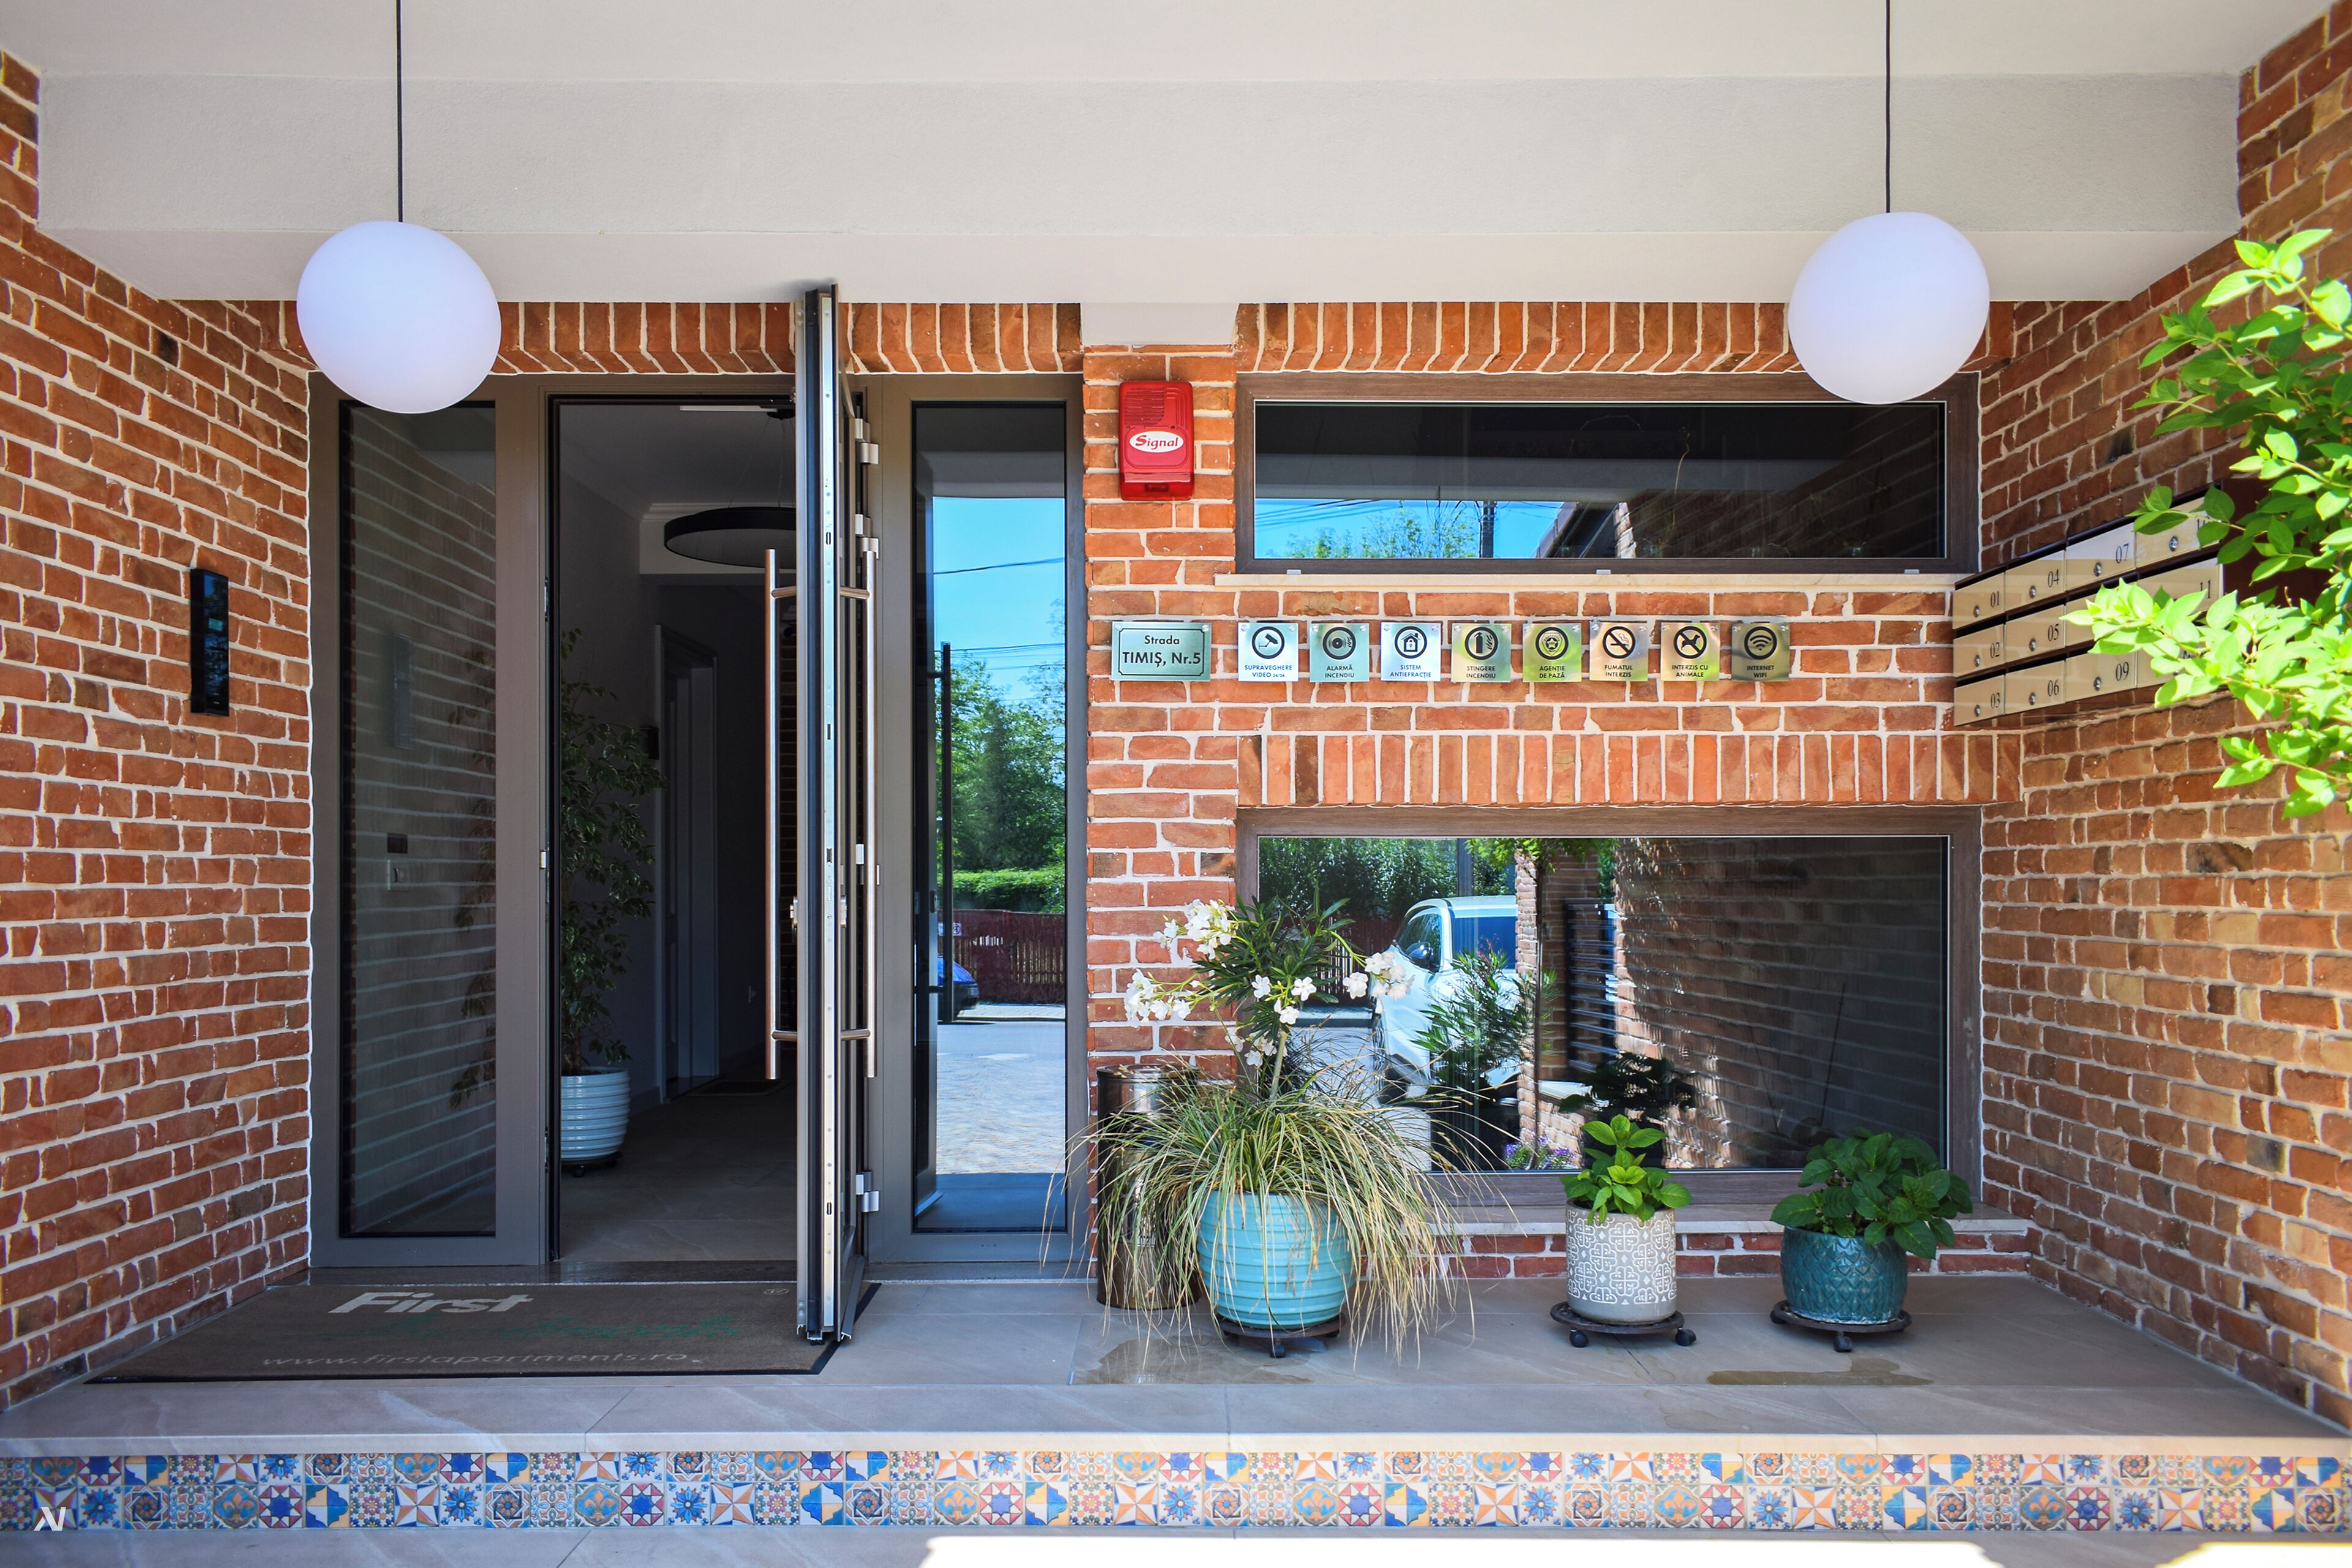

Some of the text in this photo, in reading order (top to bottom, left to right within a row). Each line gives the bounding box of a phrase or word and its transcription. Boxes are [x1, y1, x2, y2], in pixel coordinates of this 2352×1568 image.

[1135, 434, 1178, 450] Signal
[2115, 543, 2130, 564] 07
[2048, 568, 2060, 587] 04
[1990, 590, 2000, 608] 01
[1144, 635, 1180, 645] Strada
[2048, 624, 2059, 641] 05
[1990, 641, 2000, 658] 02
[1172, 652, 1201, 665] Nr.5
[2115, 662, 2130, 682] 09
[2048, 678, 2059, 697] 06
[1990, 692, 2000, 709] 03
[328, 1292, 534, 1313] First
[262, 1352, 688, 1365] www.firstapartments.ro
